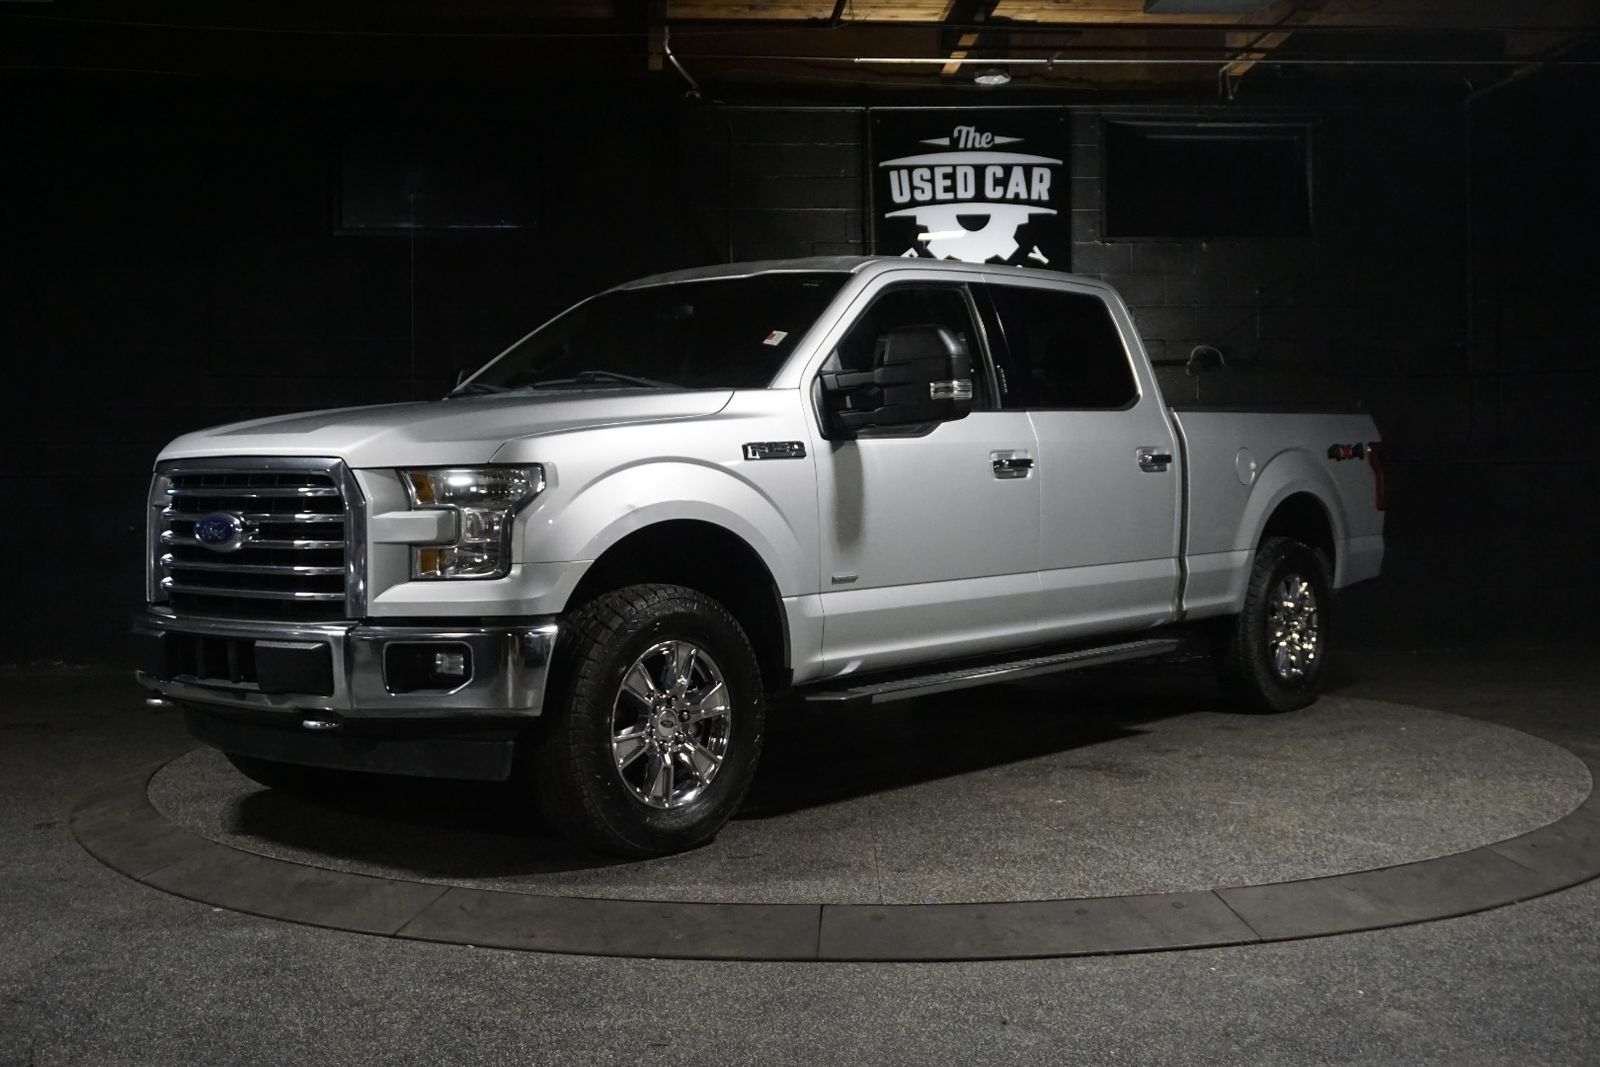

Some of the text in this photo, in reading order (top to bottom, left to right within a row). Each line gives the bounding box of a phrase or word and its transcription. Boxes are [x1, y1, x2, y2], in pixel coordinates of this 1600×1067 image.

[953, 125, 994, 148] The
[889, 165, 1052, 204] USED CAR
